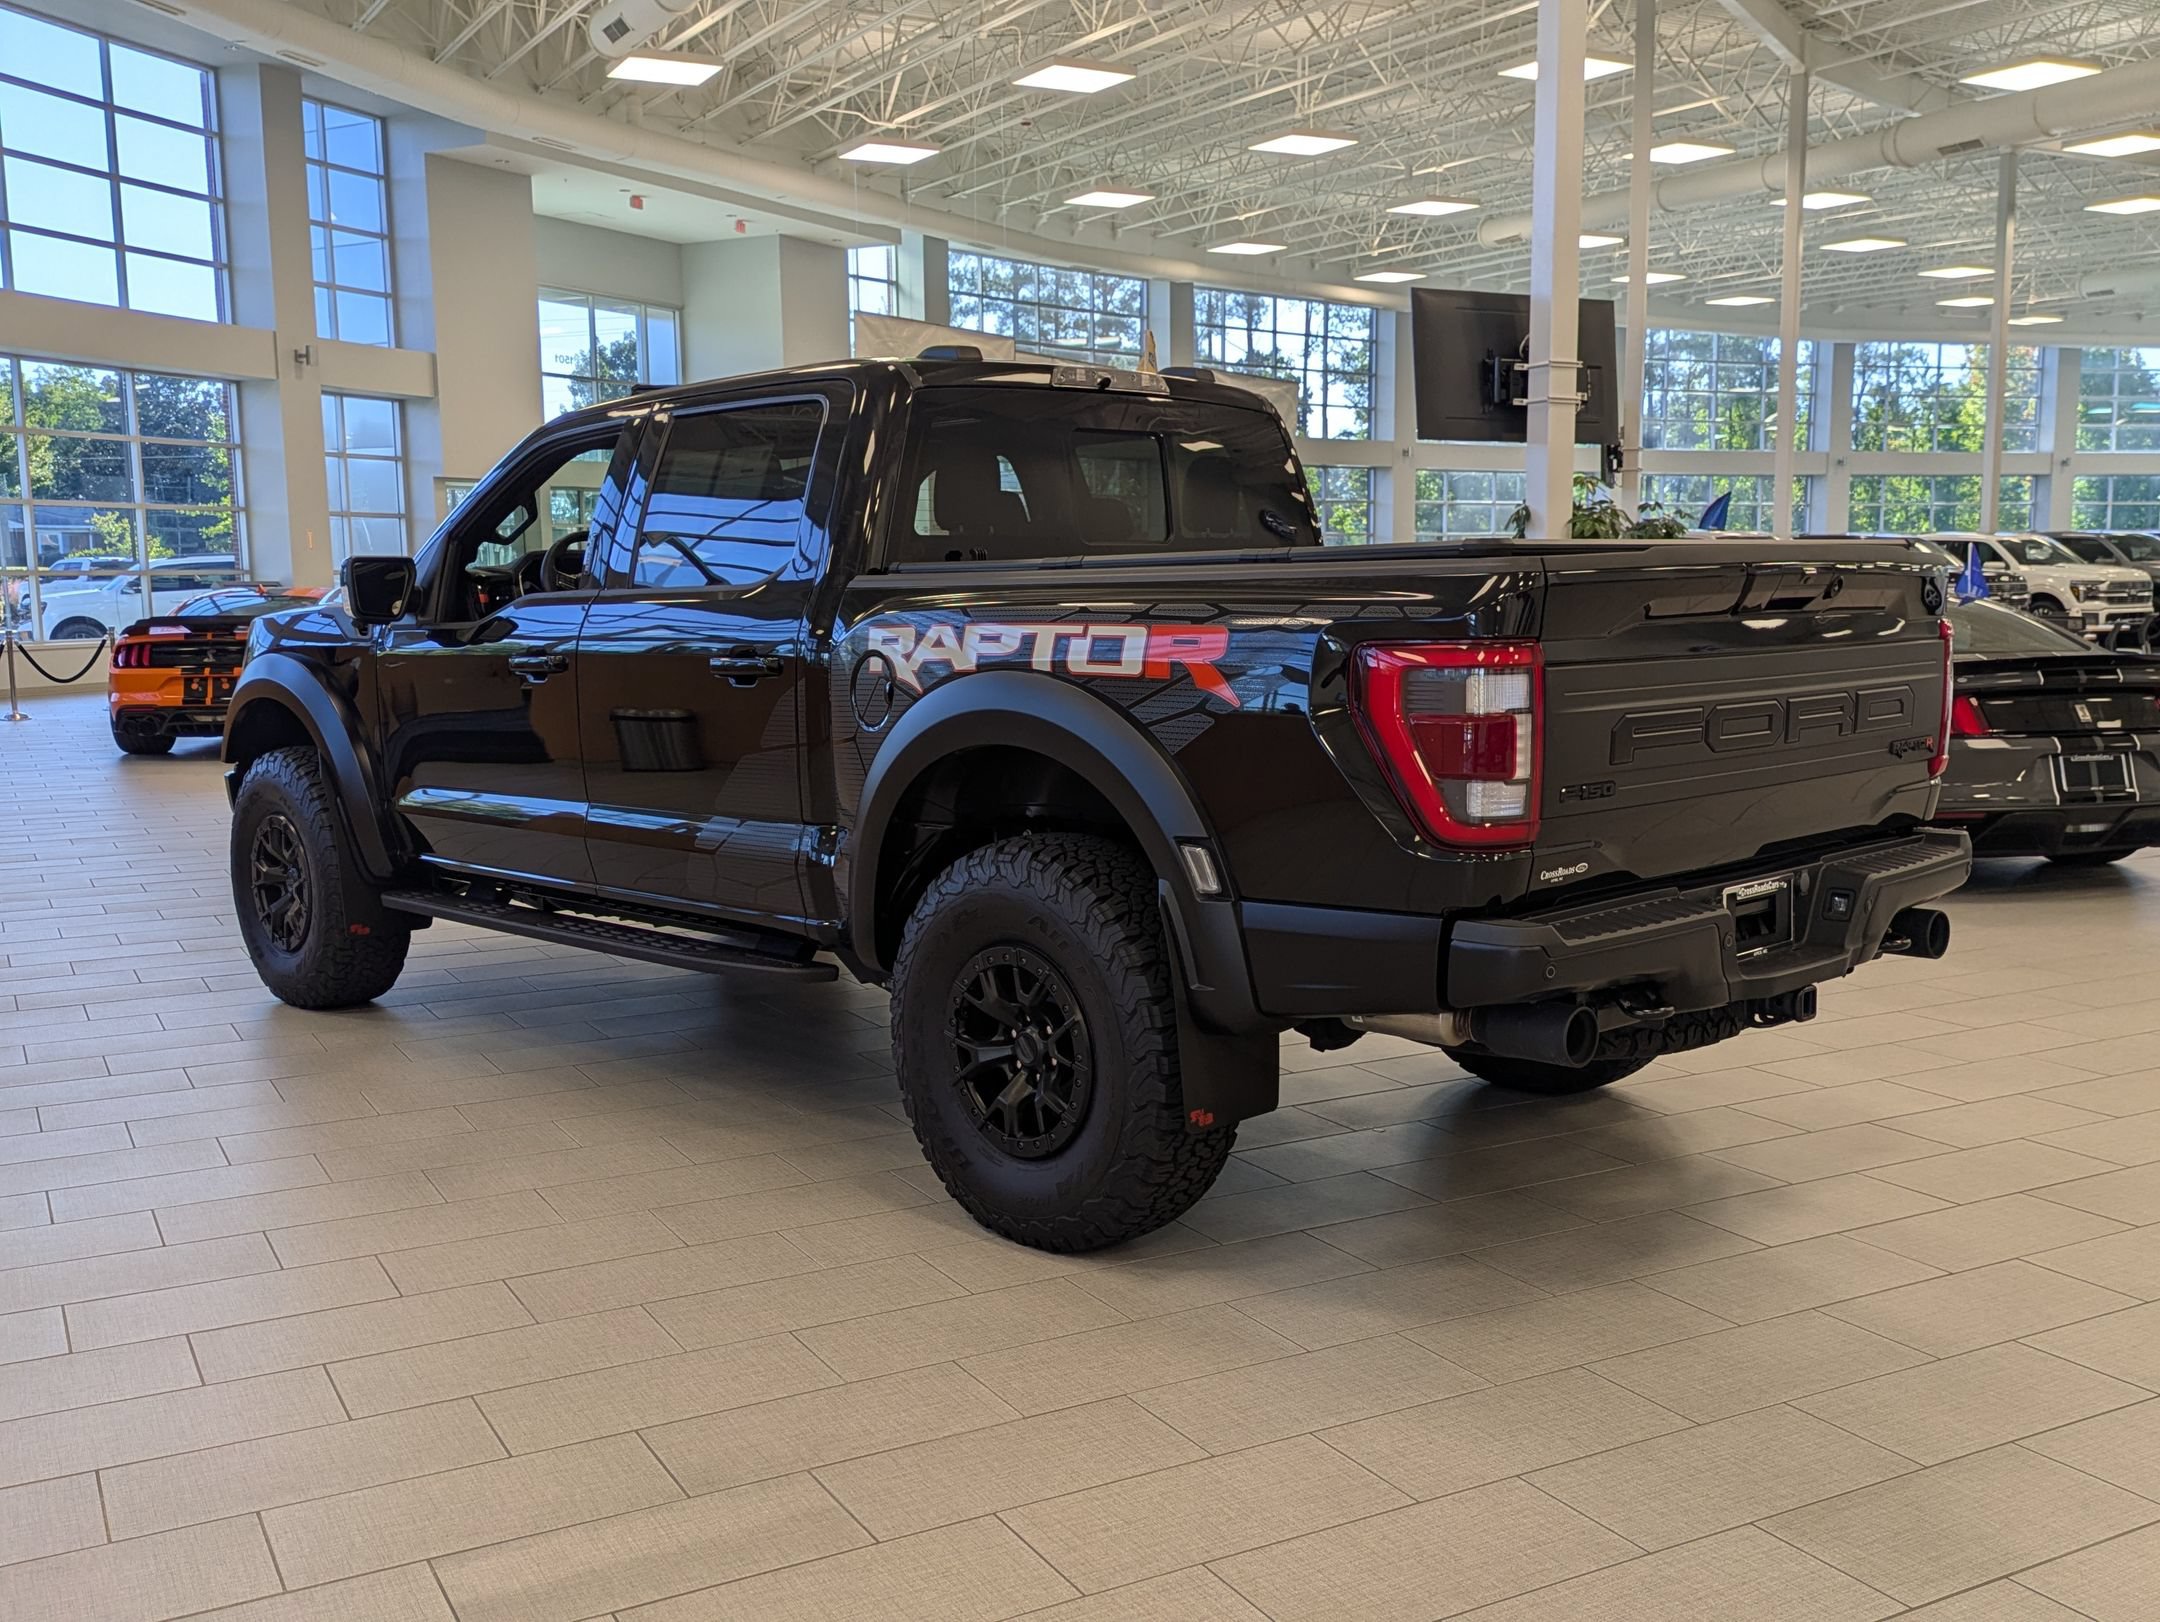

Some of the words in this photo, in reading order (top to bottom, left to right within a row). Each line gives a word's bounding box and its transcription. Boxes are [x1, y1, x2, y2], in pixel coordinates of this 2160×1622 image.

[868, 623, 1240, 708] RAPTOR
[1609, 684, 1915, 766] FORD
[1559, 780, 1616, 803] F-150
